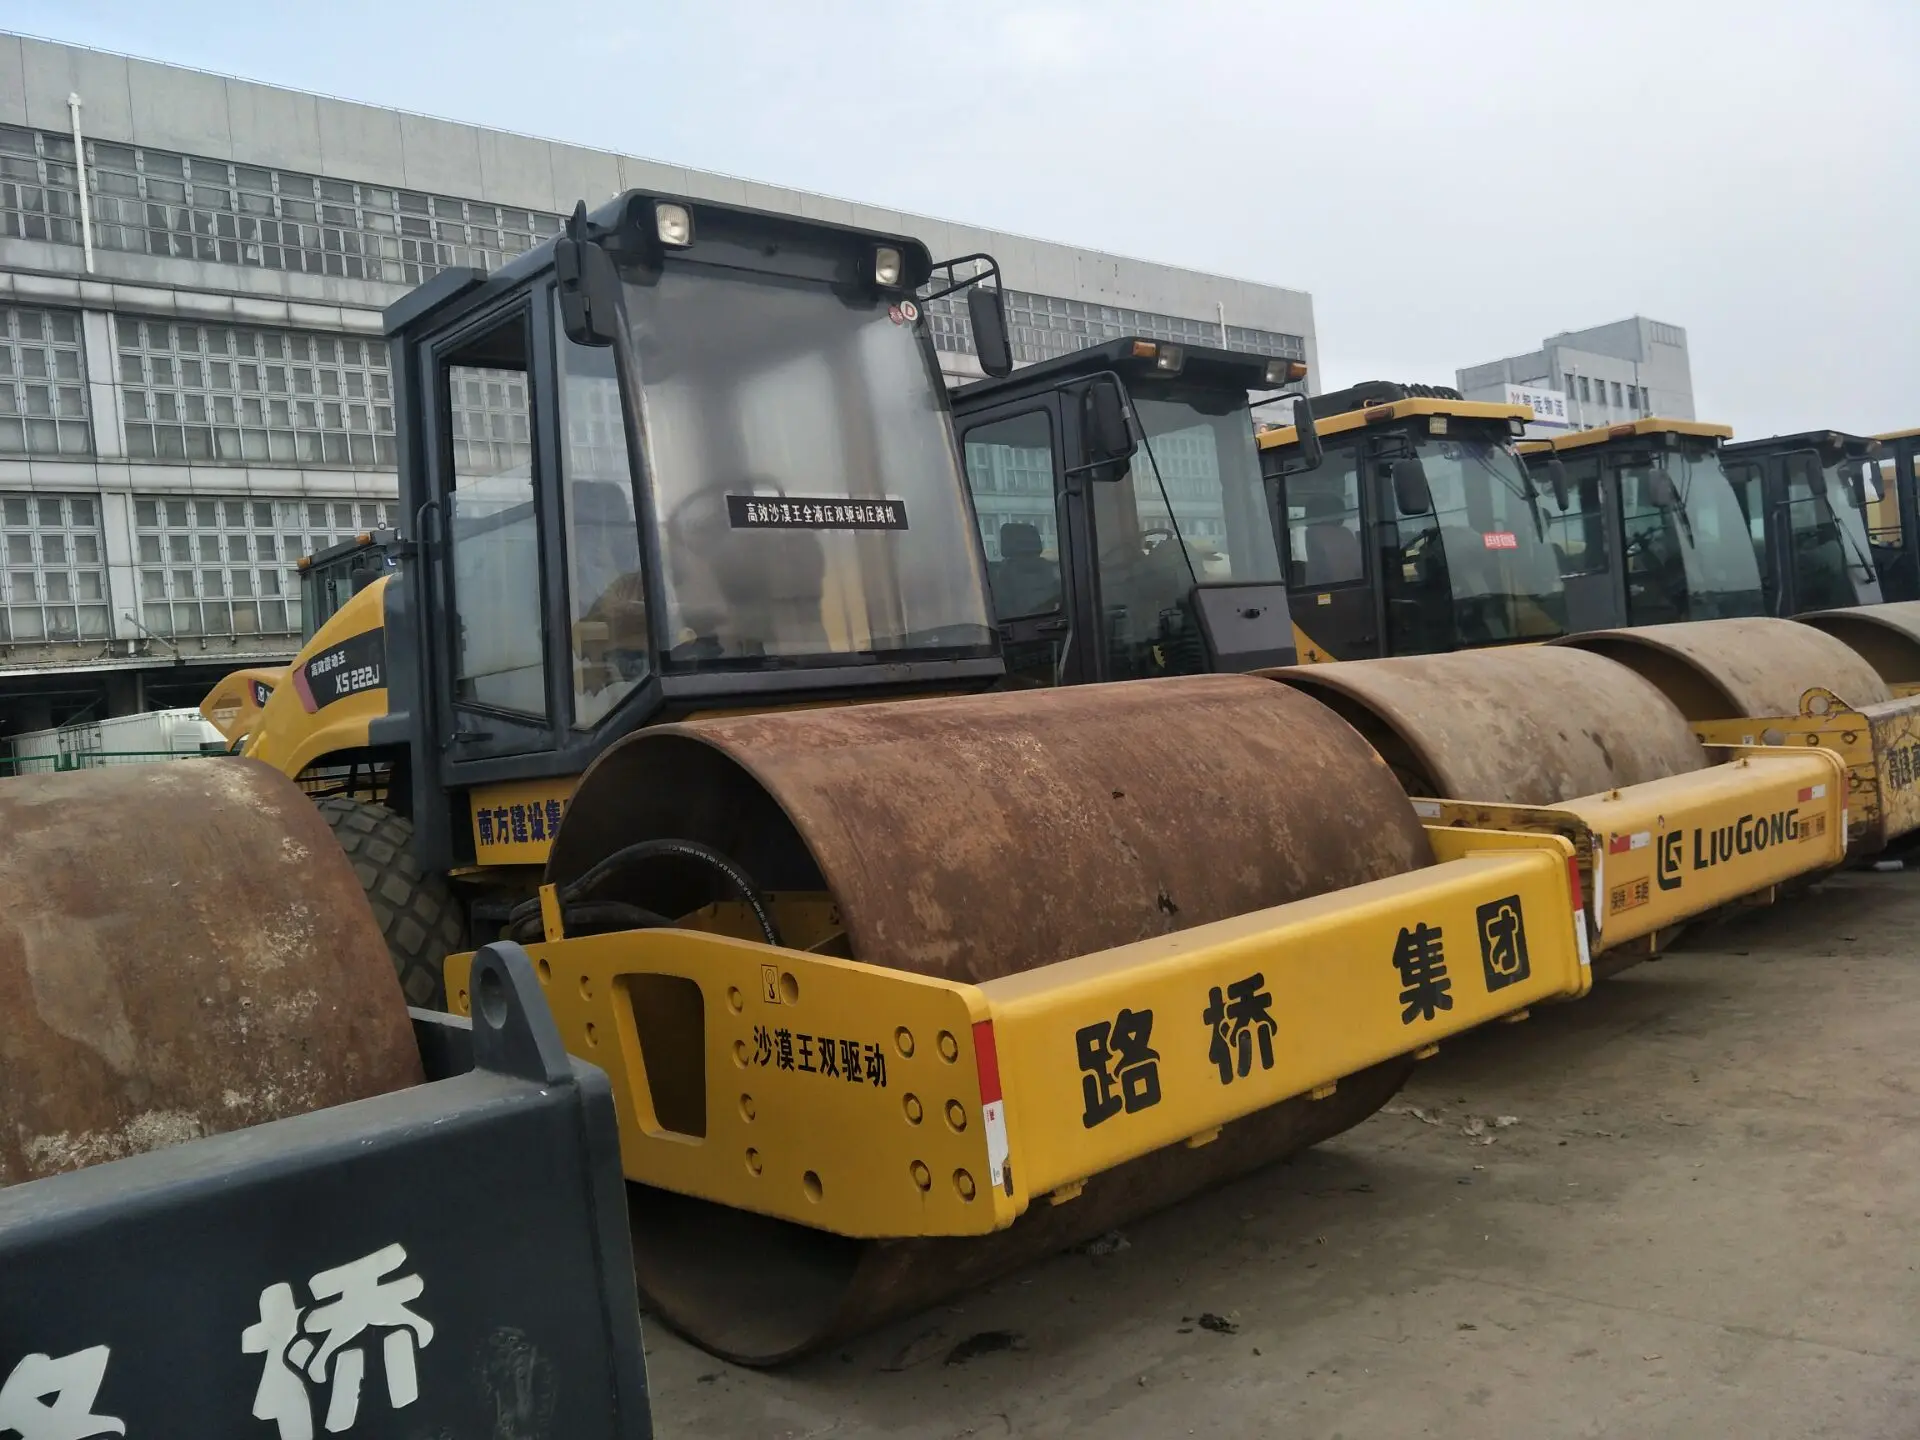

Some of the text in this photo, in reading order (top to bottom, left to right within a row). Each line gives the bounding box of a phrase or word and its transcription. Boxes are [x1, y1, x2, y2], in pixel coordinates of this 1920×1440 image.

[746, 502, 896, 523] 高效沙漠王全液压双驱动压路机
[477, 799, 568, 846] 南方建设集
[753, 1025, 887, 1088] 沙漠王双驱动
